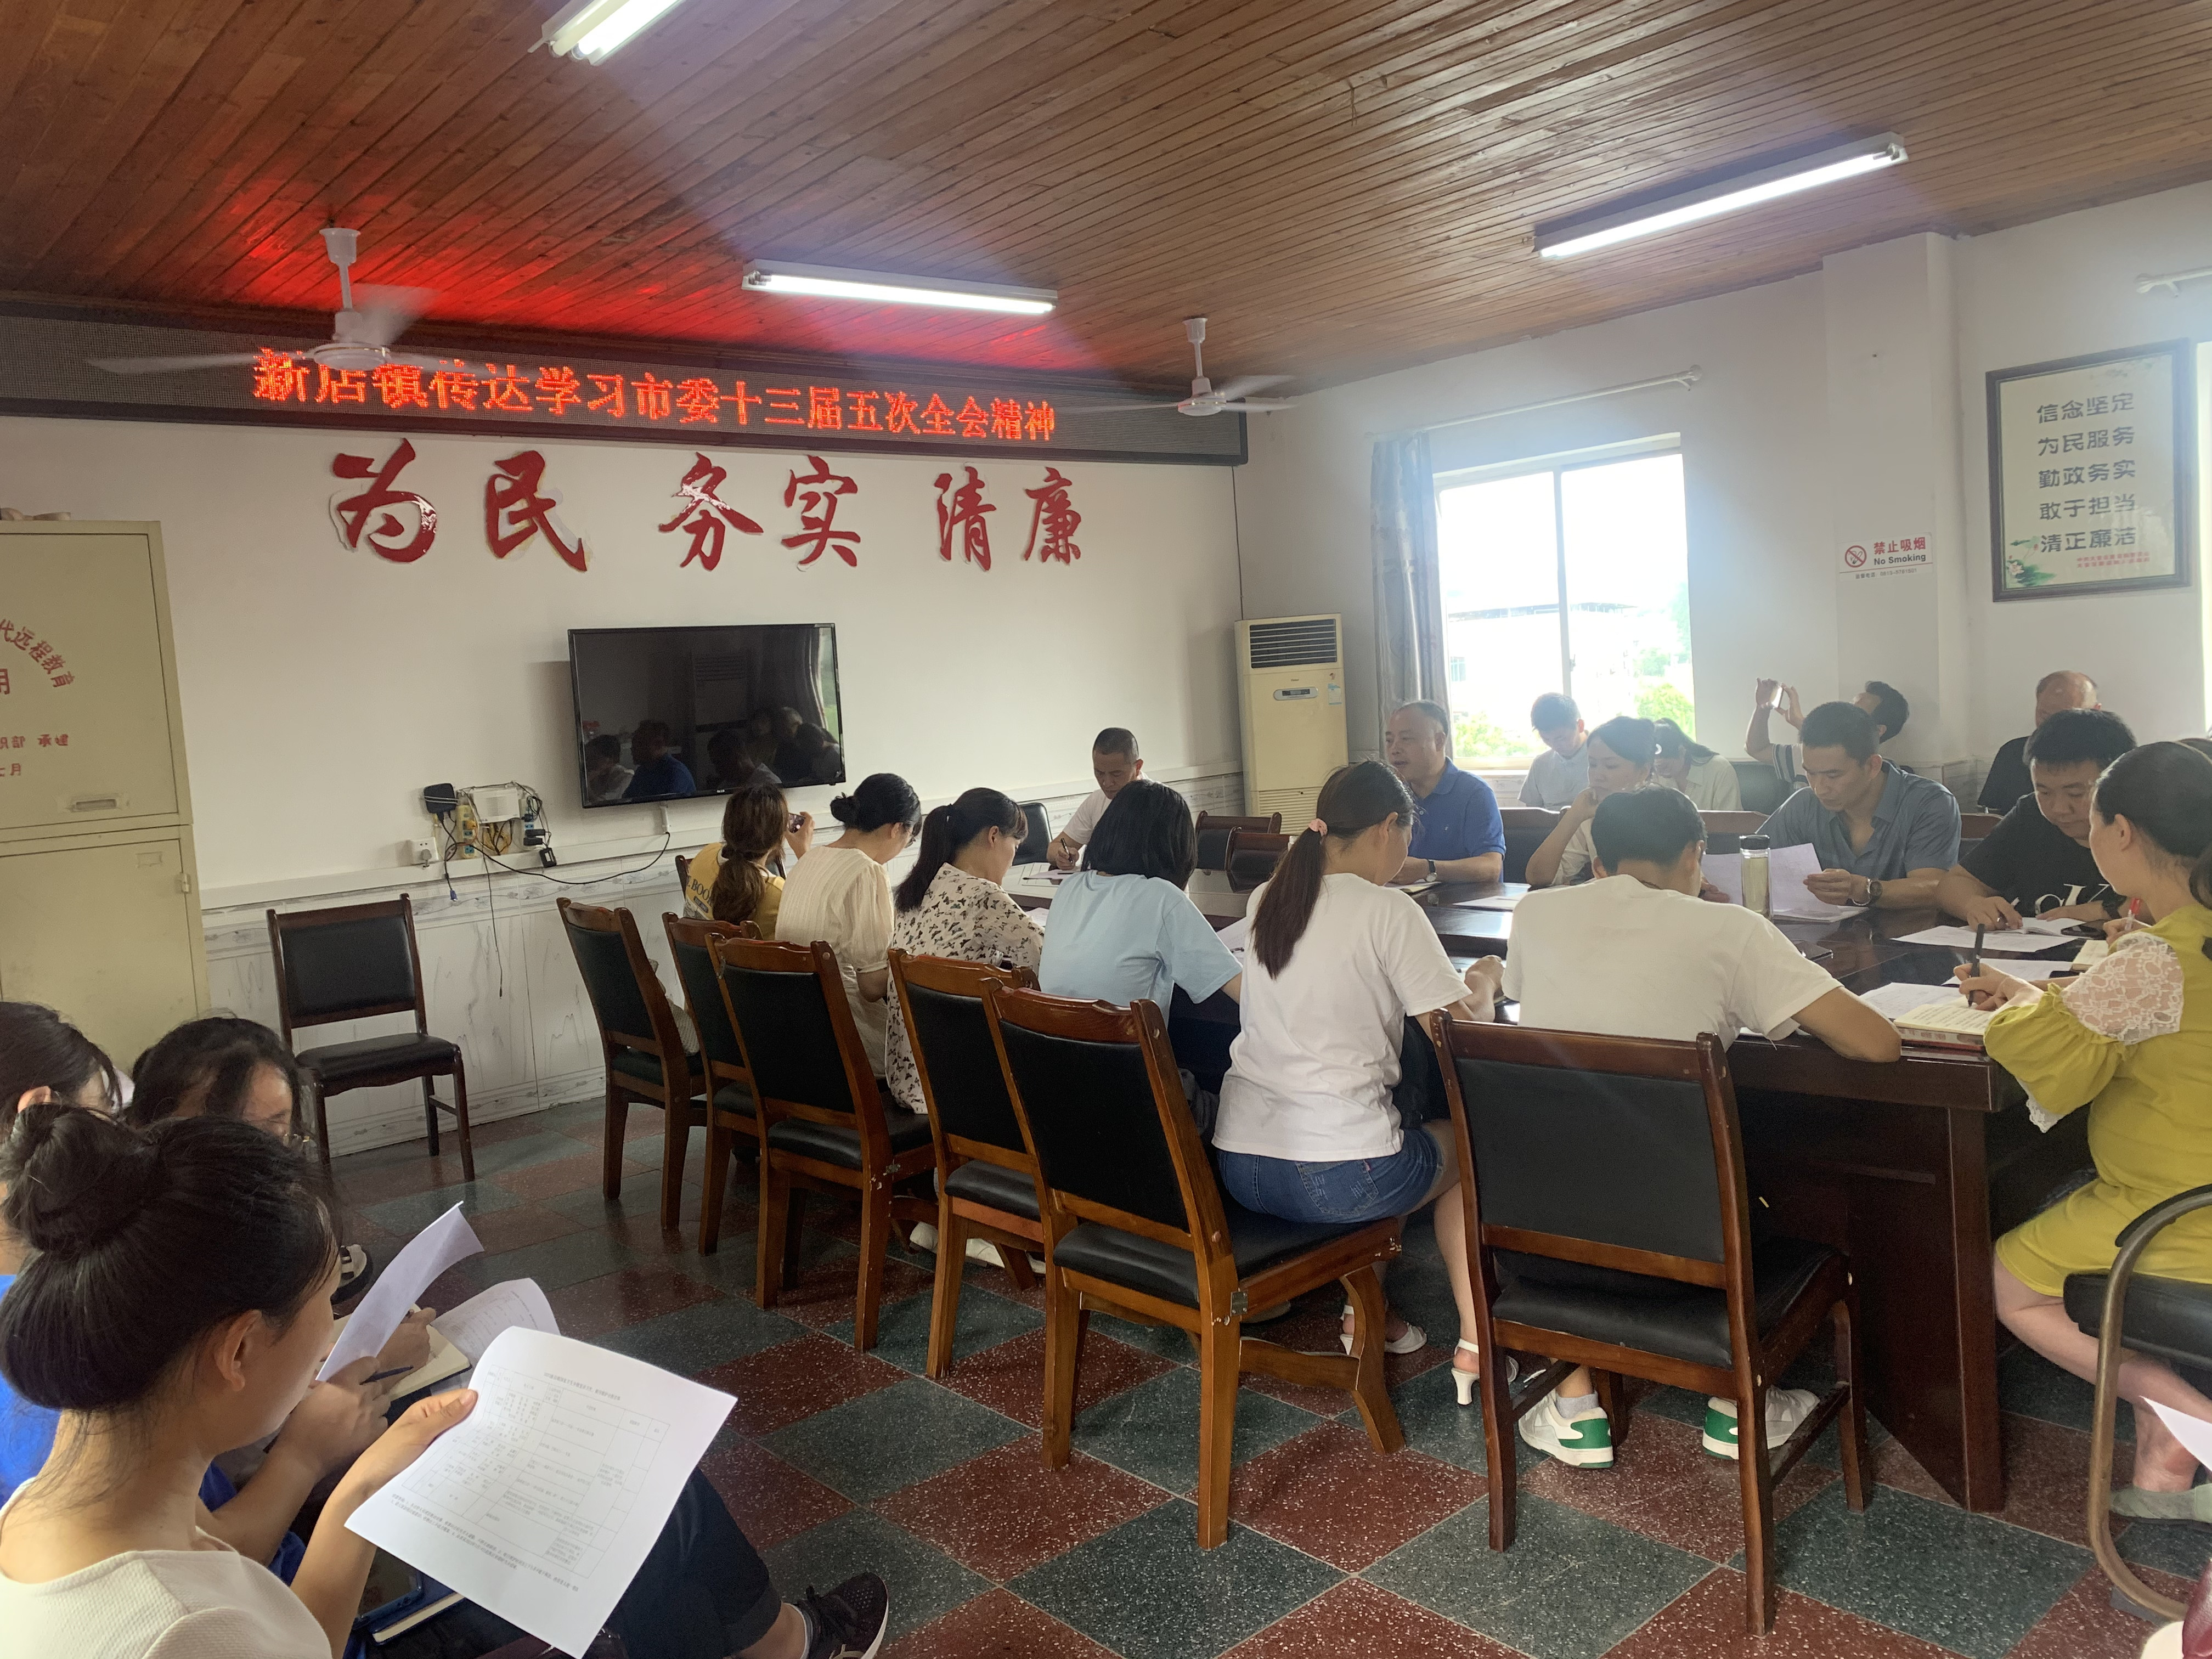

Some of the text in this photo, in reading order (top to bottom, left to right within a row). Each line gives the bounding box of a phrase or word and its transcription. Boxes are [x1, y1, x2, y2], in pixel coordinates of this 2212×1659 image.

[253, 348, 1056, 441] 新店镇传达学习市委十三届五次全会精神
[2036, 393, 2134, 424] 信念坚定
[2038, 426, 2135, 456] 为民服务
[2039, 459, 2136, 489] 勤政务实
[332, 438, 1082, 572] 为民 务实 清廉
[2040, 494, 2136, 520] 敢于担当
[1874, 537, 1926, 555] 禁止吸烟
[2041, 527, 2136, 553] 清正廉洁
[1888, 554, 1926, 564] Smoking
[691, 878, 713, 906] BOO
